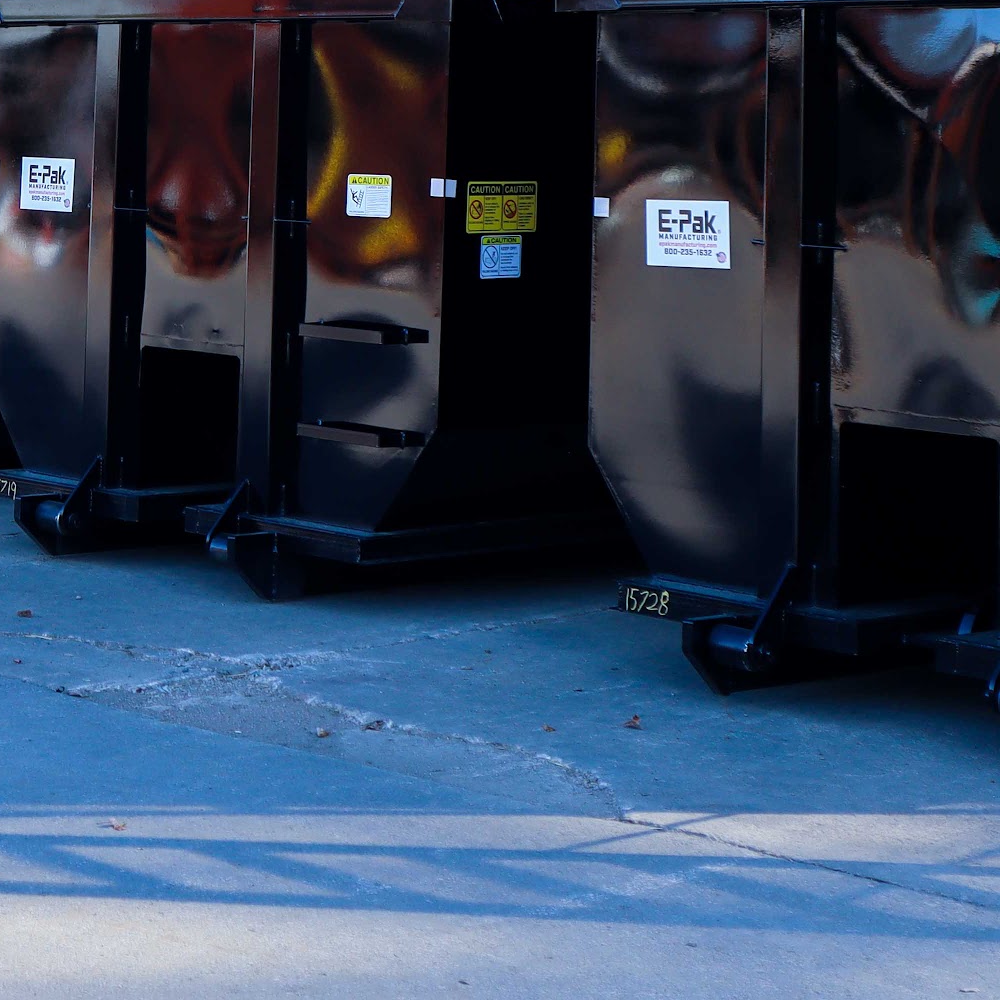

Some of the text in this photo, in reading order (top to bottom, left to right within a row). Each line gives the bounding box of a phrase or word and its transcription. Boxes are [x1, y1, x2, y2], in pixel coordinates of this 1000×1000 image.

[29, 165, 66, 184] E-Pak
[357, 176, 389, 185] CAUTION
[470, 185, 534, 194] CAUTION CAUTION
[658, 209, 716, 234] E-Pak
[658, 233, 718, 241] MANUFACTURING
[625, 588, 670, 616] 15728
